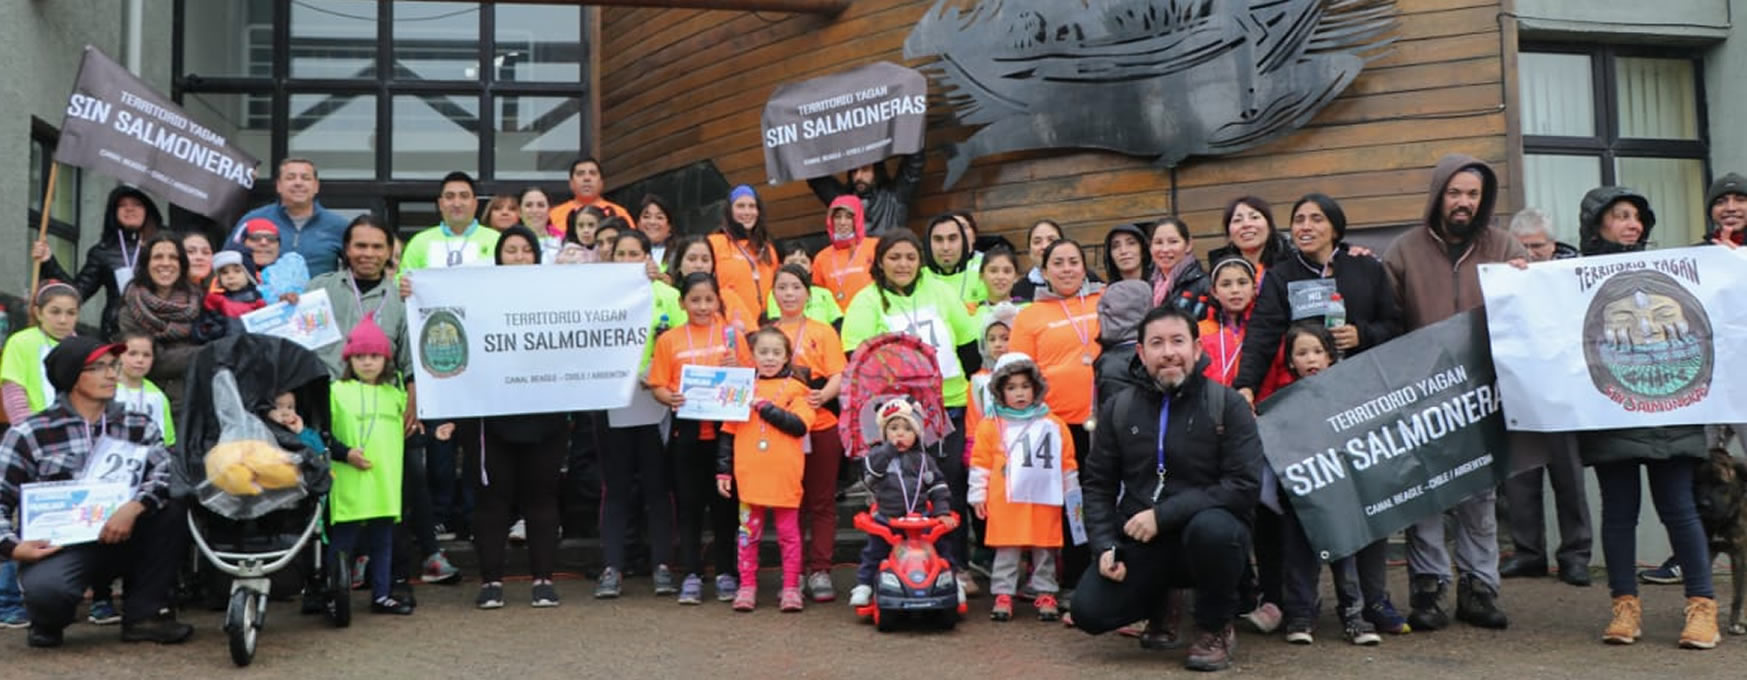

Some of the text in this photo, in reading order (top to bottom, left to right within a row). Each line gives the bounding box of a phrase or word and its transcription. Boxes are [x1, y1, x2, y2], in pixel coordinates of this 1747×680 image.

[120, 90, 226, 147] TERRITORIO YAGAN
[766, 95, 926, 148] SIN SALMONERAS
[797, 85, 888, 116] TERRITORIO YAGAN
[67, 93, 255, 190] SIN SALMONERAS
[504, 309, 628, 326] TERRITORIO YAGAN
[484, 327, 648, 353] SIN SALMONERAS
[1326, 365, 1468, 433] TERRITORIO YAGAN
[1018, 431, 1054, 469] 14
[1285, 384, 1501, 496] SIN SALMONERA
[99, 453, 142, 488] 23
[1365, 499, 1394, 516] CANAL
[1393, 486, 1425, 504] BEAGLE
[1428, 472, 1450, 489] CHILE
